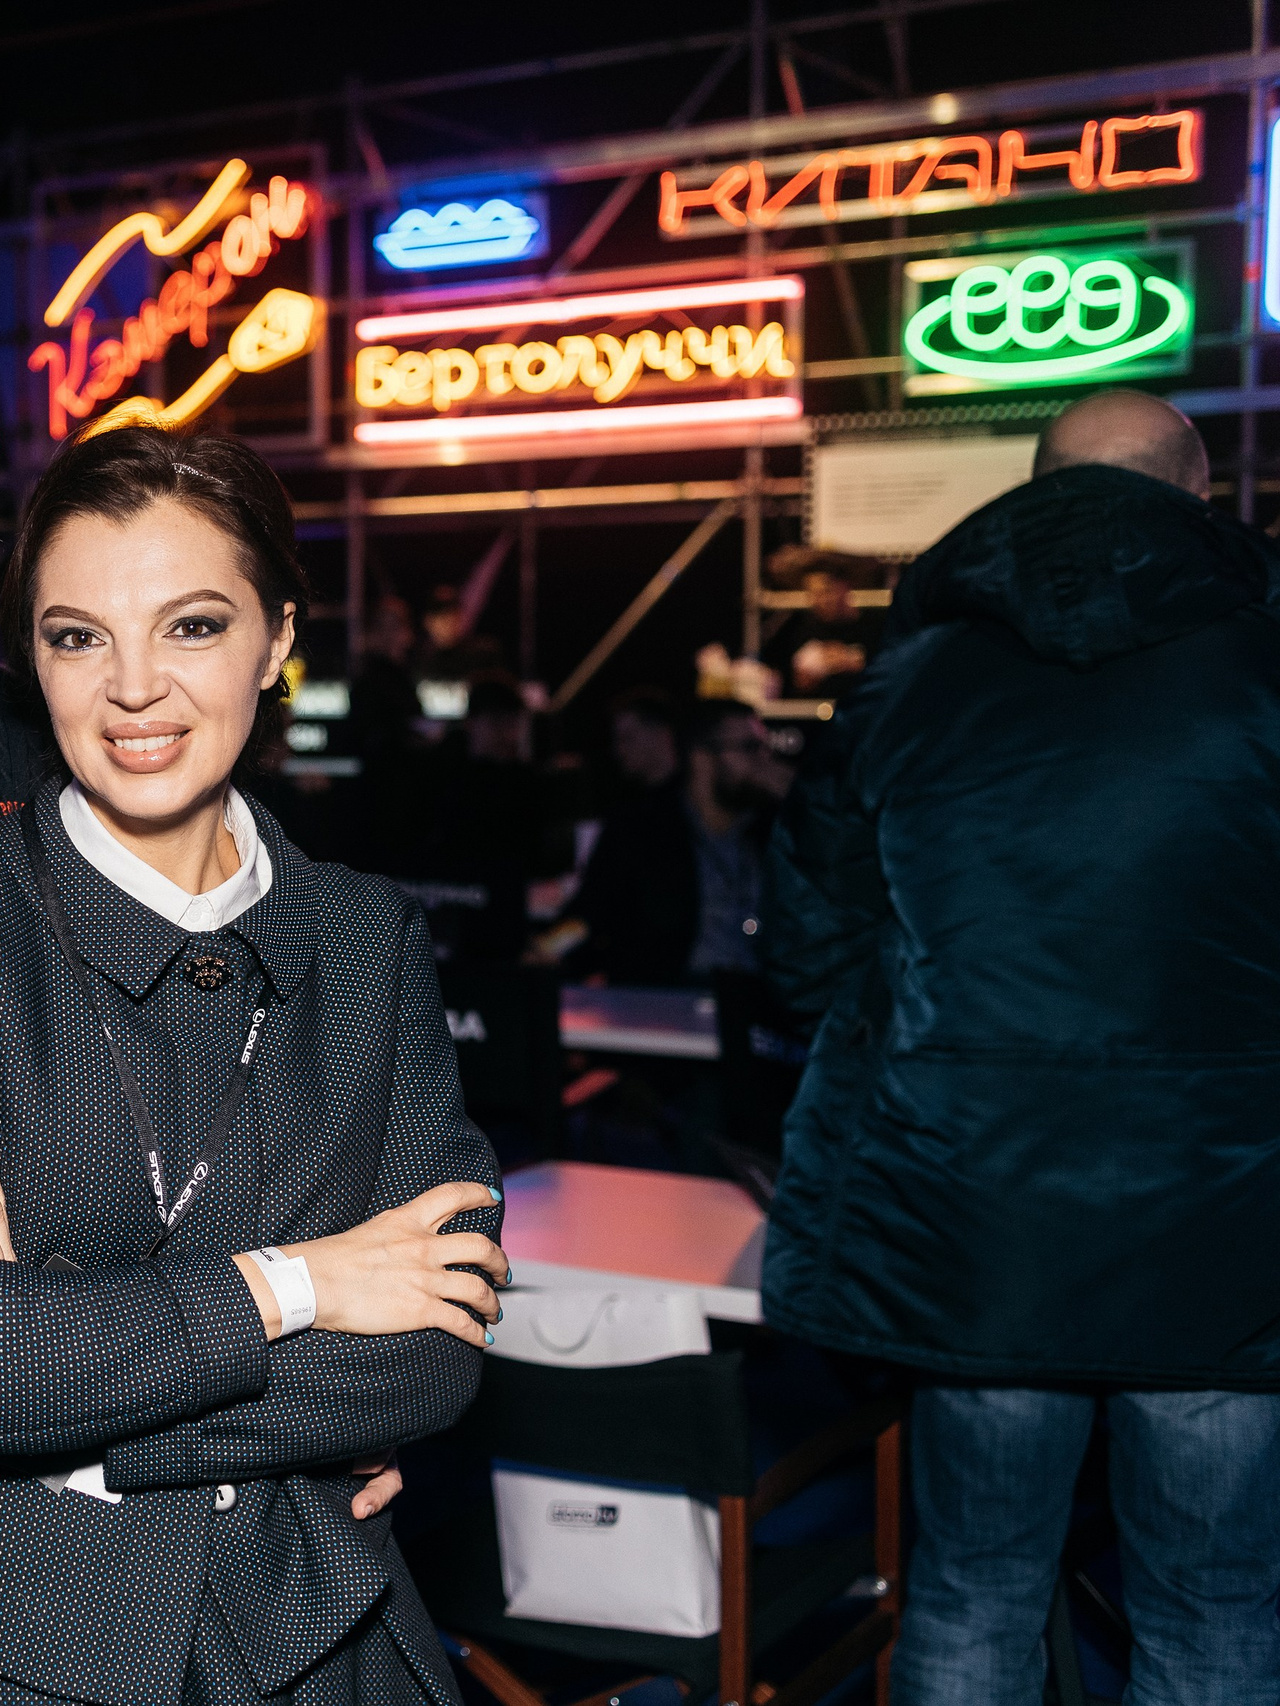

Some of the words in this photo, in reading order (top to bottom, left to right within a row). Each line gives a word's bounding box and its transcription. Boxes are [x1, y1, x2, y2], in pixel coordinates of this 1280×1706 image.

[659, 110, 1196, 234] КИТАНО
[355, 322, 796, 412] Бертолуччи
[241, 1023, 260, 1064] LEXUS
[149, 1151, 163, 1204] LEXUS
